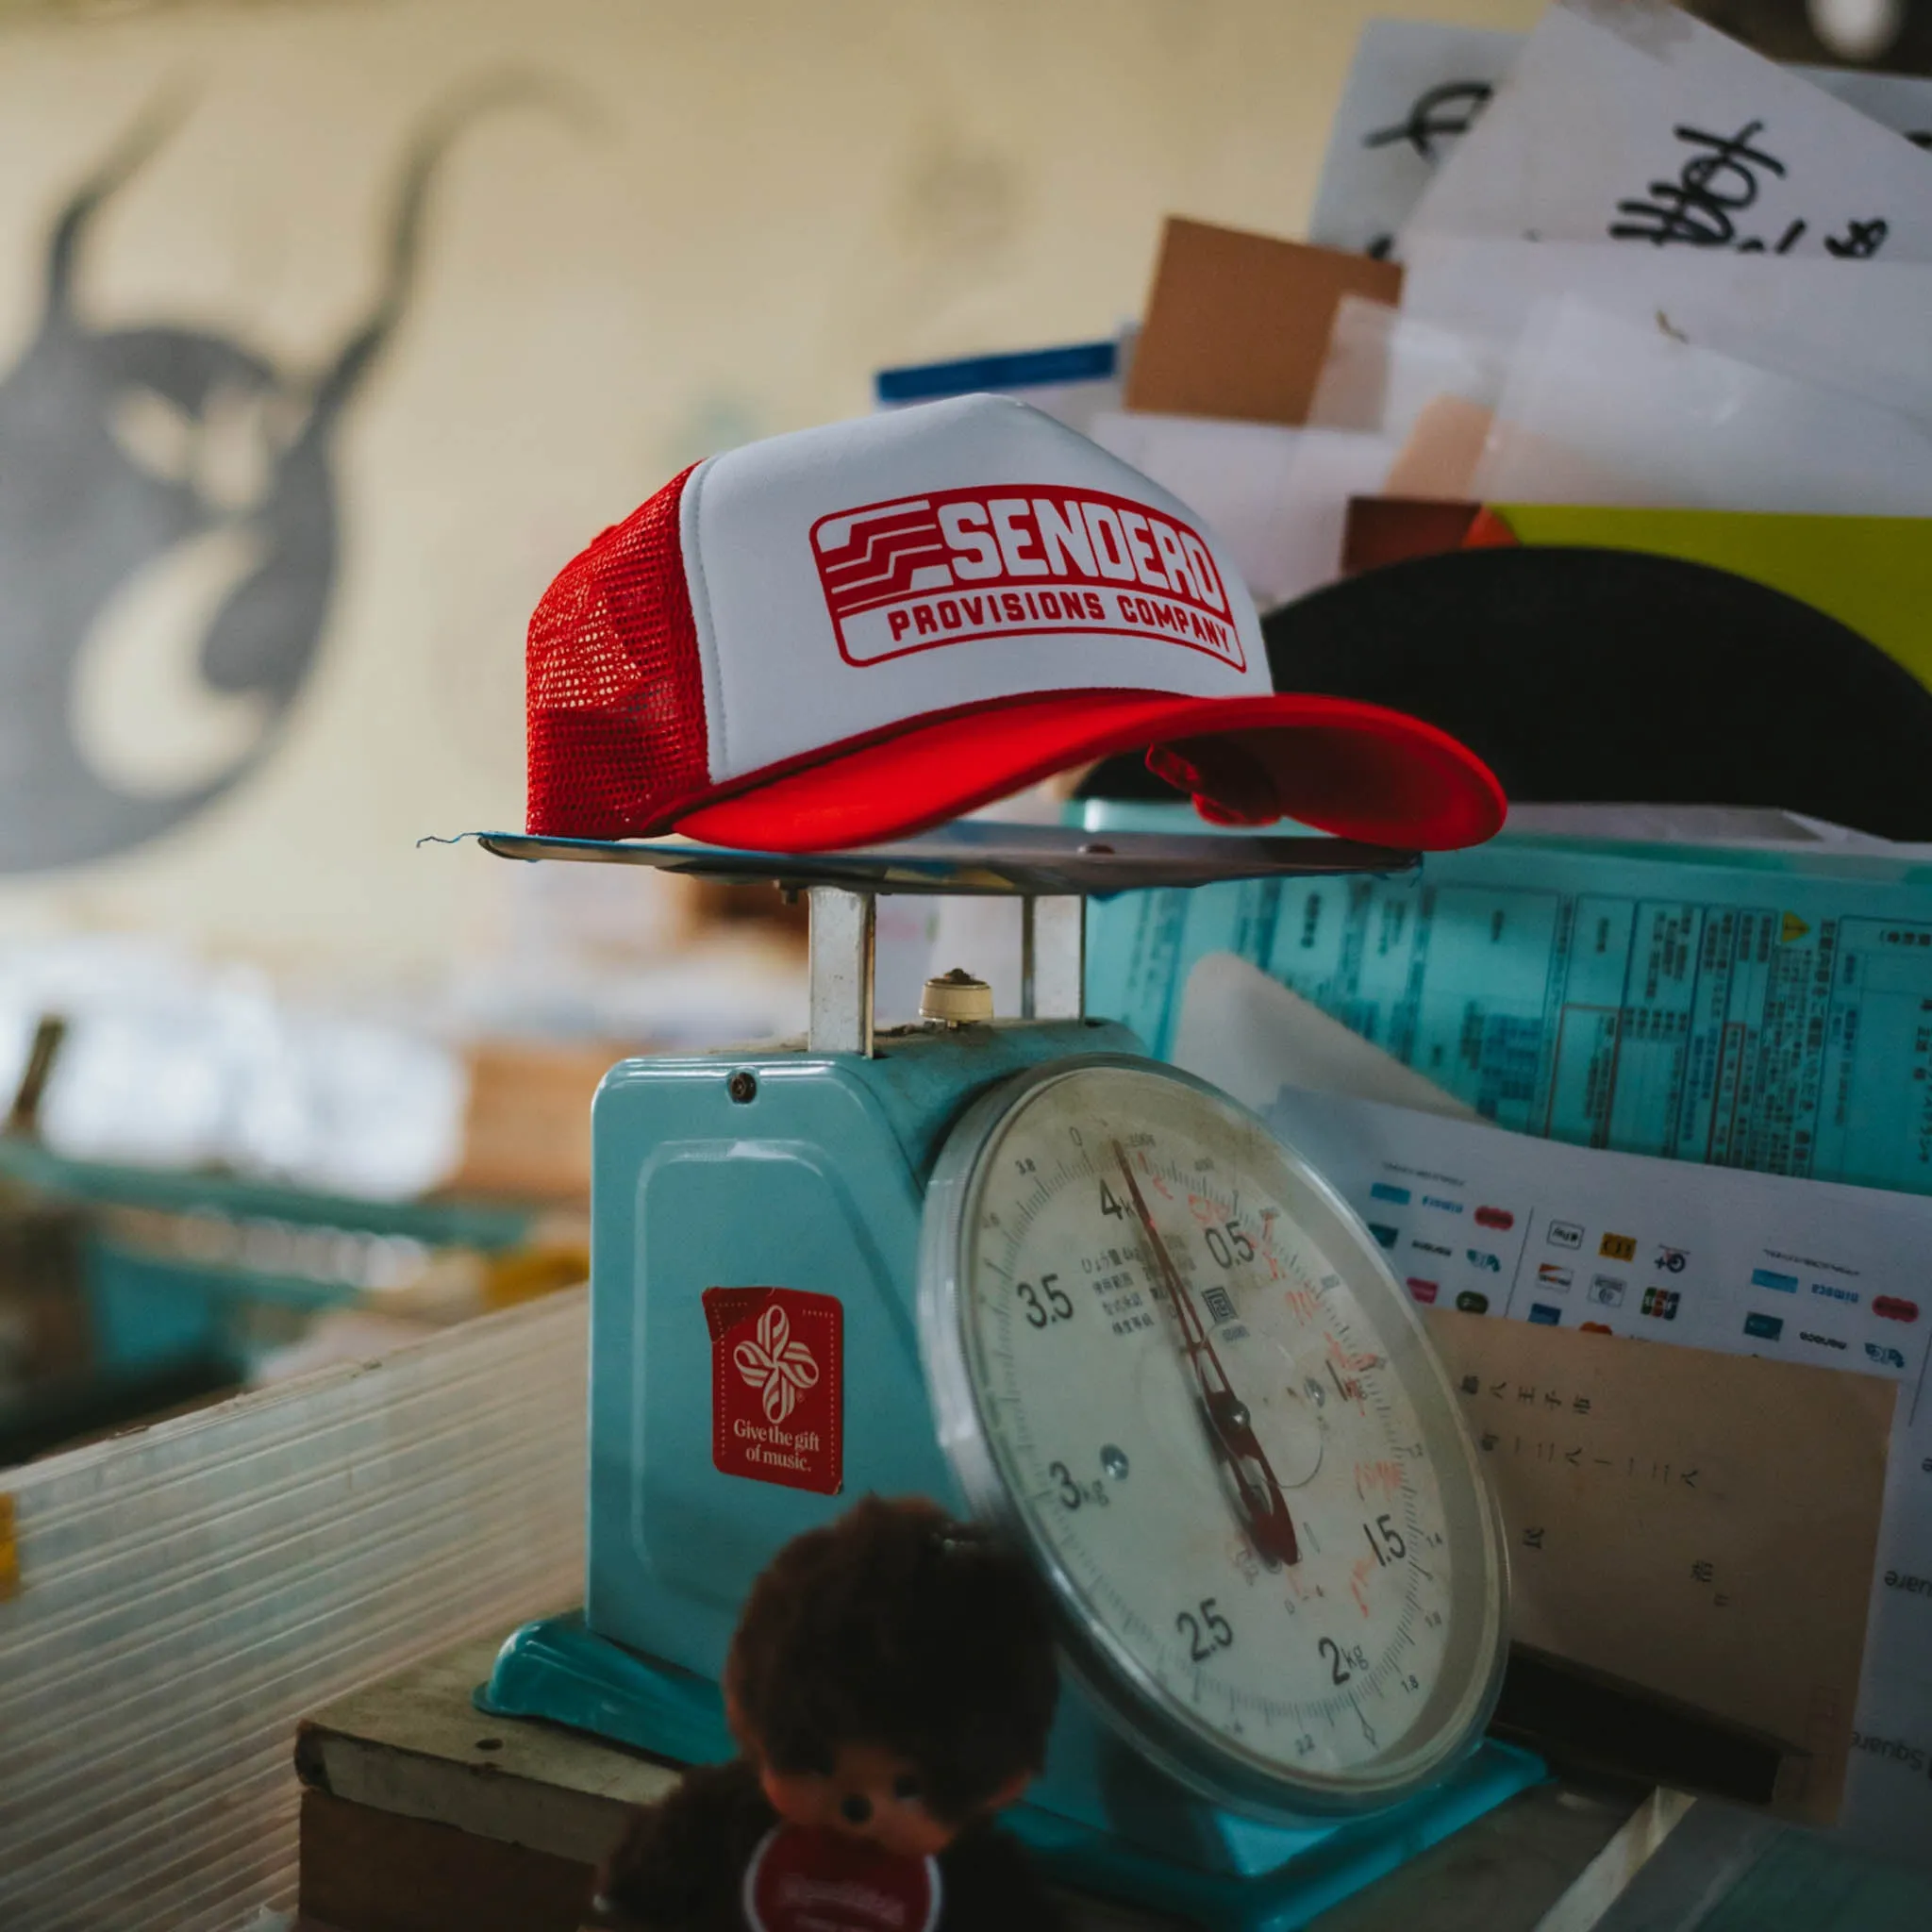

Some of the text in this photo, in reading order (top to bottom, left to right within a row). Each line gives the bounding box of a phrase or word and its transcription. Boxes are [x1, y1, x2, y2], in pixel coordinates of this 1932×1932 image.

[937, 498, 1225, 613] SENDERO
[887, 591, 1230, 653] PROVISIONS COMPANY
[1099, 1178, 1136, 1221] 4k
[1204, 1221, 1255, 1269] 0.5
[1017, 1273, 1074, 1328] 3.5
[733, 1418, 820, 1453] Give the gift
[745, 1443, 812, 1473] of music.
[1362, 1513, 1407, 1568] 1.5
[1884, 1570, 1932, 1599] uare
[1174, 1597, 1234, 1662] 2.5
[1318, 1636, 1370, 1686] 2kg
